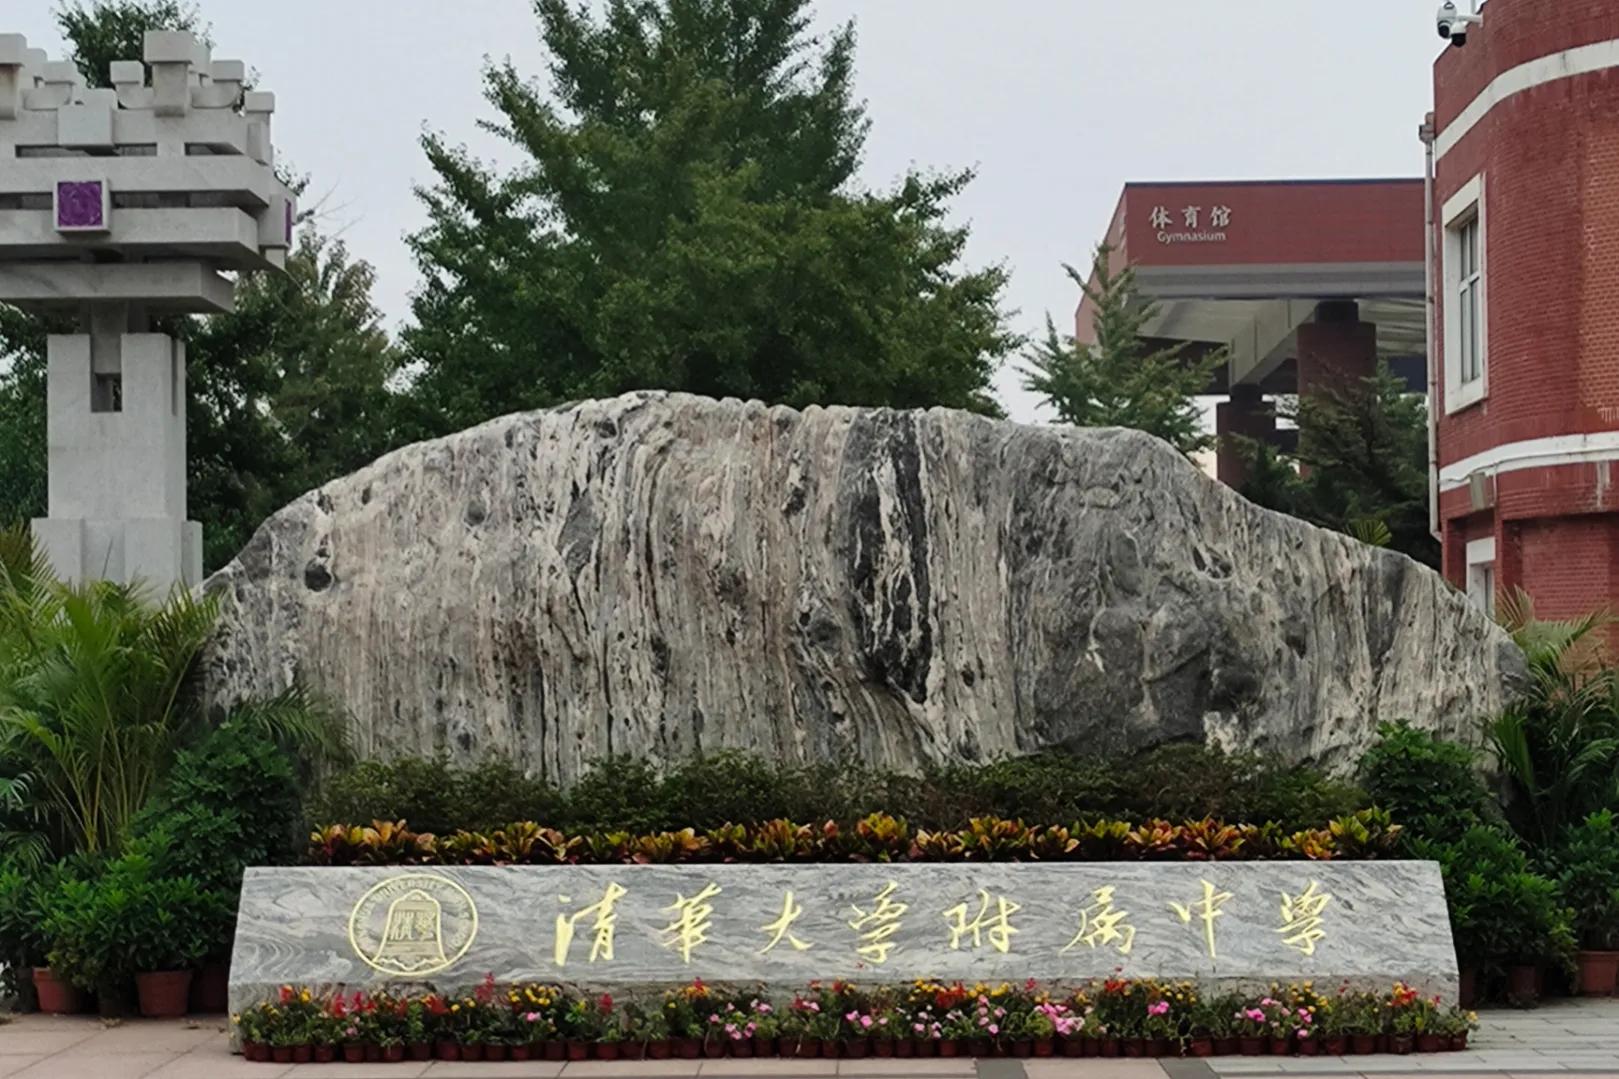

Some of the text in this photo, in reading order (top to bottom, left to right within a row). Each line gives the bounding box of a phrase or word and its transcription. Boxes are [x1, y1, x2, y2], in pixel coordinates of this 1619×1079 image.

[1149, 205, 1232, 229] 体育馆
[1157, 231, 1226, 244] Gymnasium
